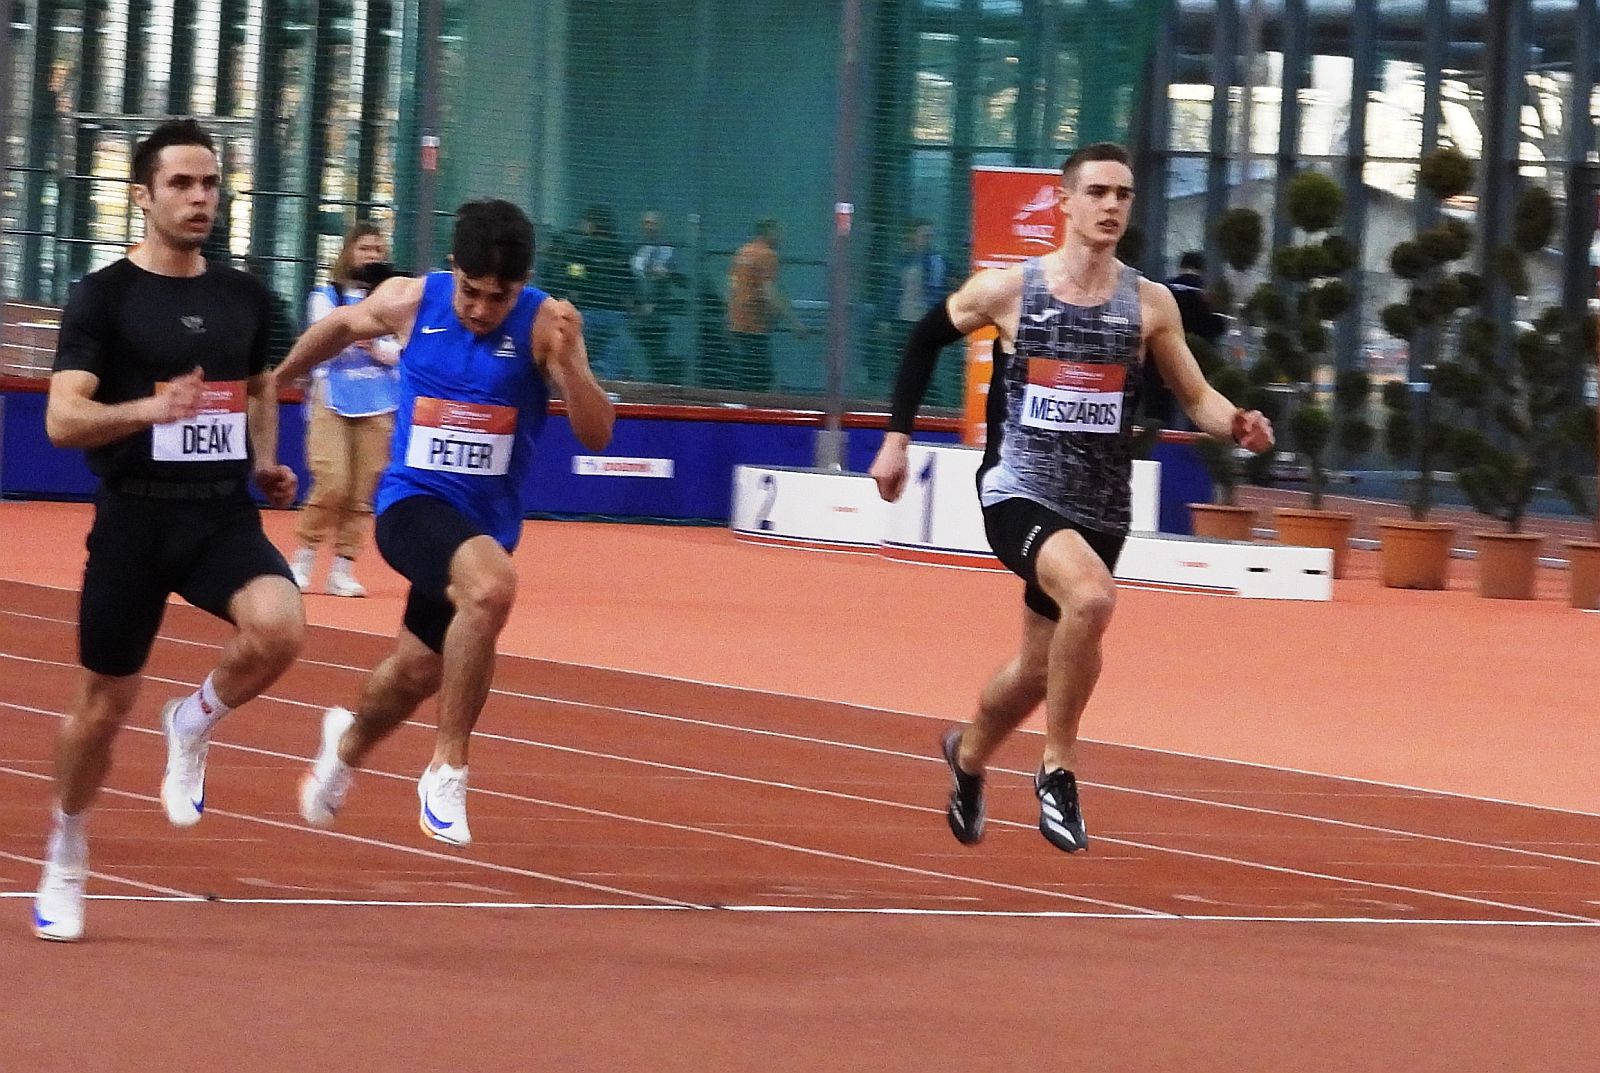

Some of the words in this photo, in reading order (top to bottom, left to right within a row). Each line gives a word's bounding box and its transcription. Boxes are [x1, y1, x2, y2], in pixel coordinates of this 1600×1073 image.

[1030, 395, 1118, 426] MÉSZÁROS
[182, 418, 233, 454] DEÁK
[430, 433, 494, 469] PÉTER
[757, 474, 778, 531] 2
